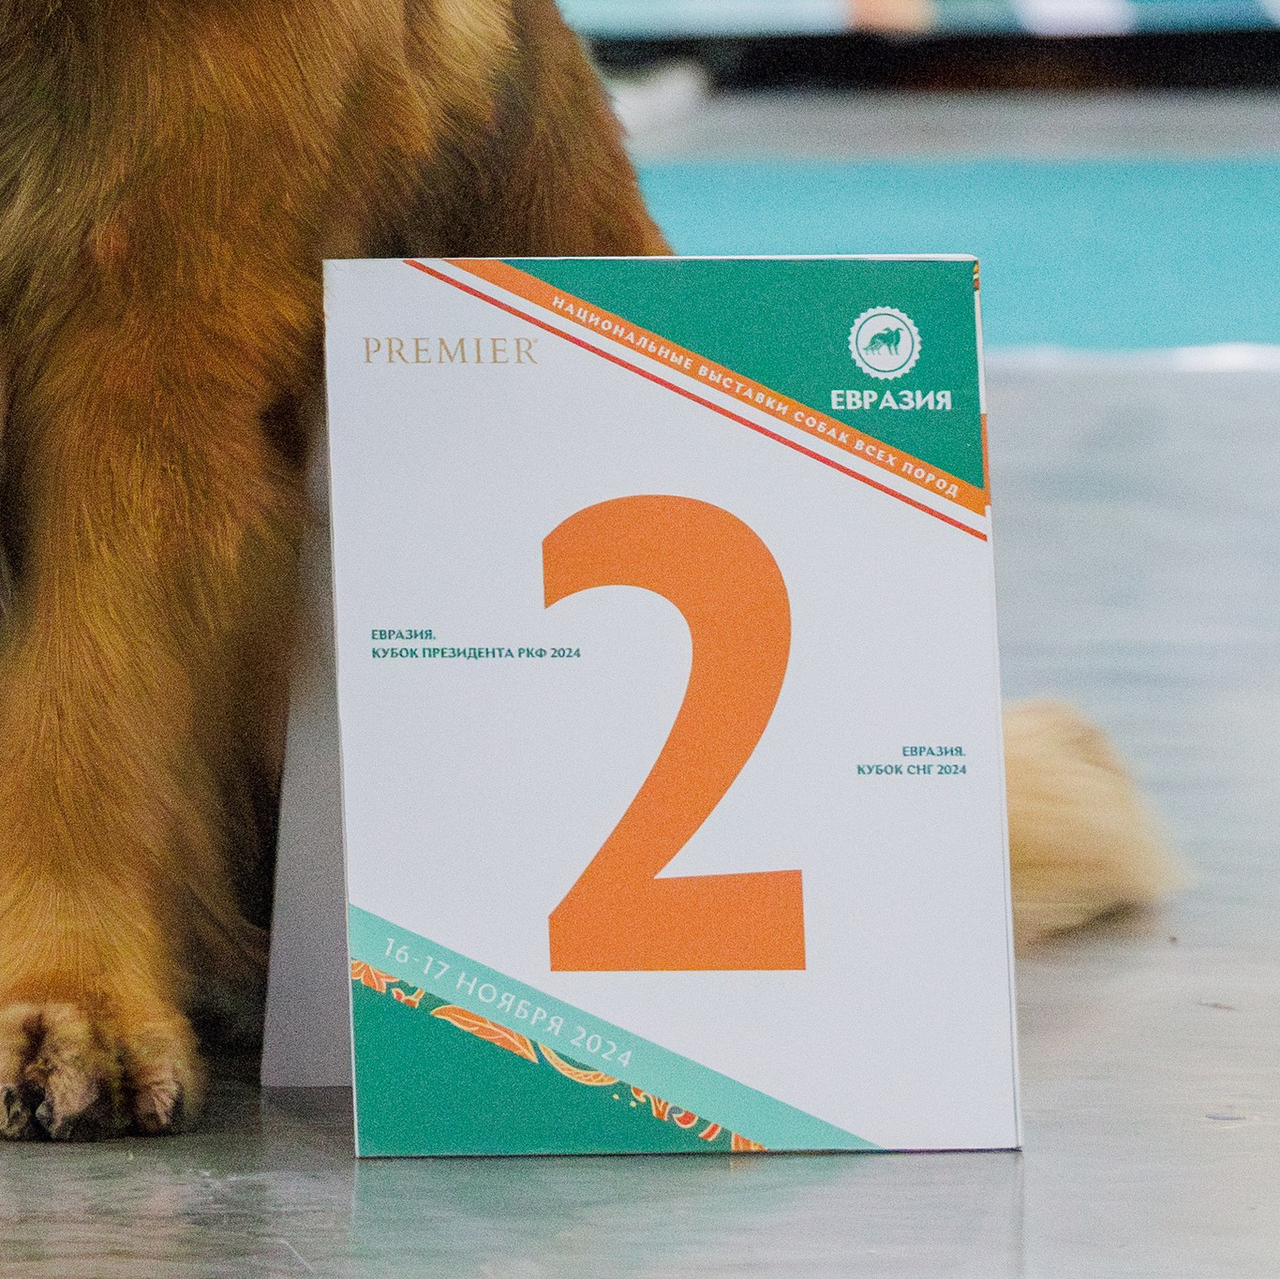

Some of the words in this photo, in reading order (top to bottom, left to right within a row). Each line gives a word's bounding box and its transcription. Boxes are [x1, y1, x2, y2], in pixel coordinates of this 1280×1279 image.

[362, 336, 539, 365] PREMIER
[552, 296, 693, 370] НАЦИОНАЛЬНЫЕ
[697, 365, 789, 415] ВЫСТАВКИ
[793, 411, 850, 444] СОБАК
[853, 440, 897, 466] ВСЕХ
[901, 462, 960, 499] ПОРОД
[830, 389, 953, 411] ЕВРАЗИЯ
[370, 628, 437, 640] ЕВРАЗИЯ.
[371, 647, 419, 659] КУБОК
[421, 647, 515, 660] ПРЕЗИДЕНТА
[517, 647, 548, 659] РКФ
[550, 647, 582, 659] 2024
[542, 494, 806, 972] 2
[902, 745, 967, 757] ЕВРАЗИЯ.
[856, 764, 904, 776] КУБОК
[906, 764, 934, 776] СНГ
[936, 764, 968, 776] 2024
[383, 937, 451, 981] 16-17
[455, 971, 566, 1037] НОЯБРЯ
[570, 1026, 633, 1068] 2024
